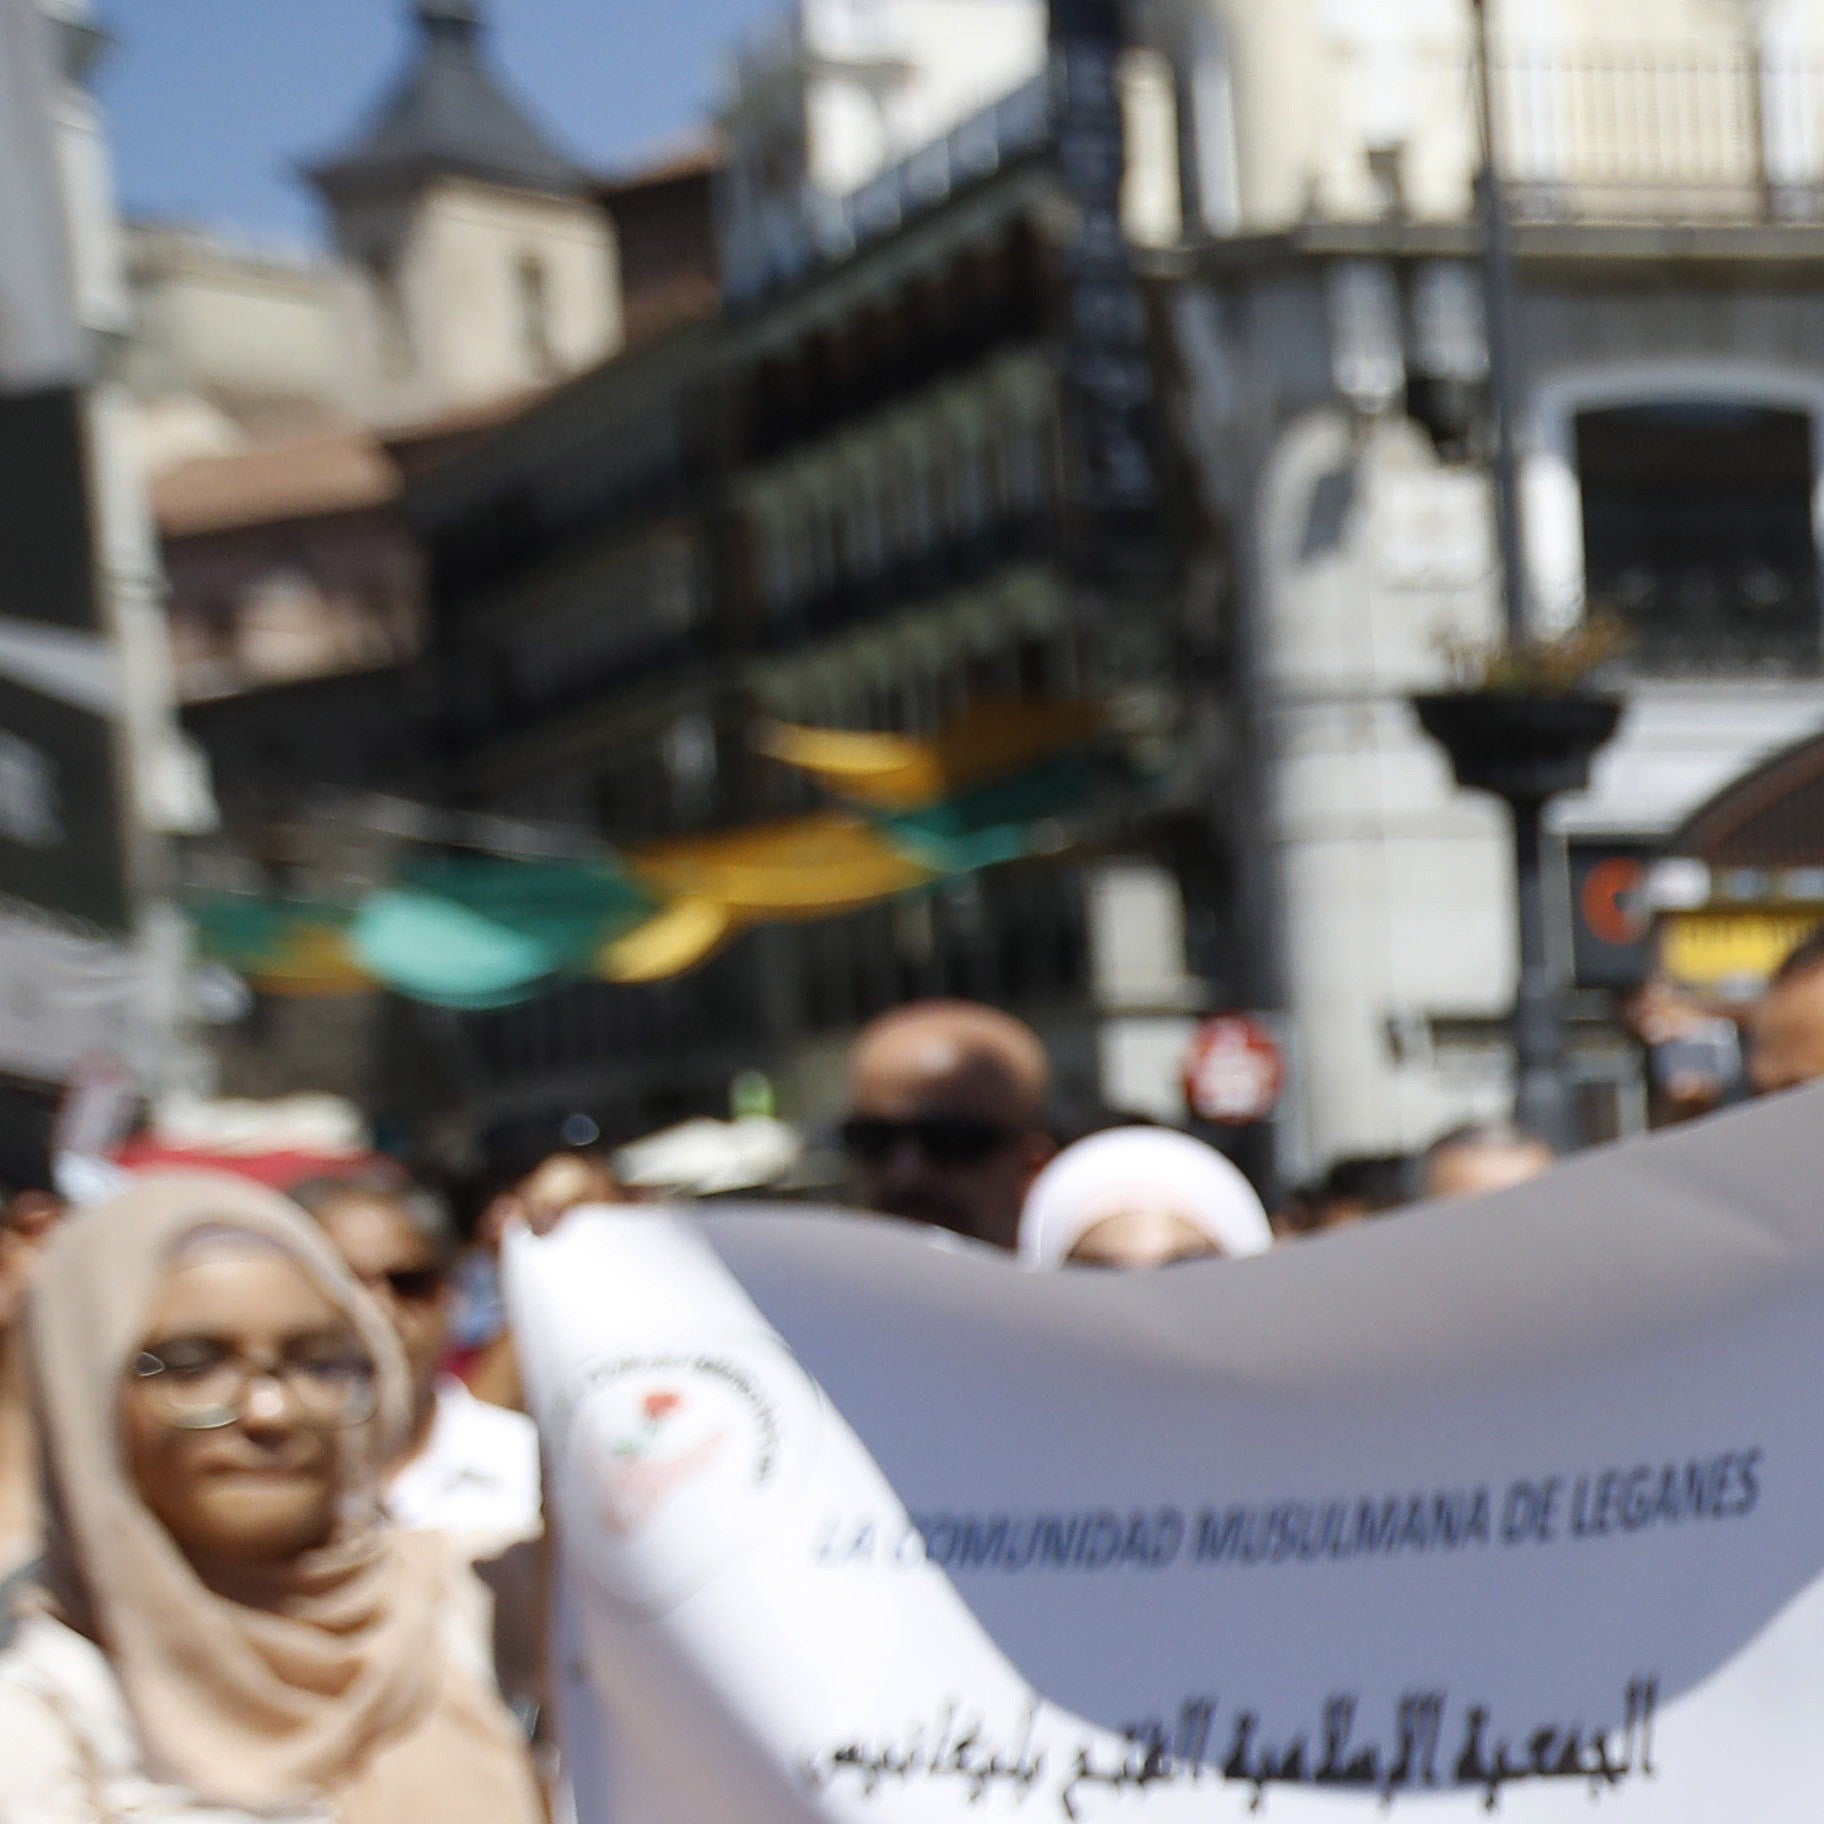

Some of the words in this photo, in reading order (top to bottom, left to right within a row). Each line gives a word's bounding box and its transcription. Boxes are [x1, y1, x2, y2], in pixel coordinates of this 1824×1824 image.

[815, 1512, 878, 1569] LA
[894, 1505, 1187, 1573] COMUNIDAD
[1195, 1483, 1490, 1565] MUSULMANA
[1501, 1473, 1566, 1547] DE
[1571, 1444, 1763, 1538] LEGANES
